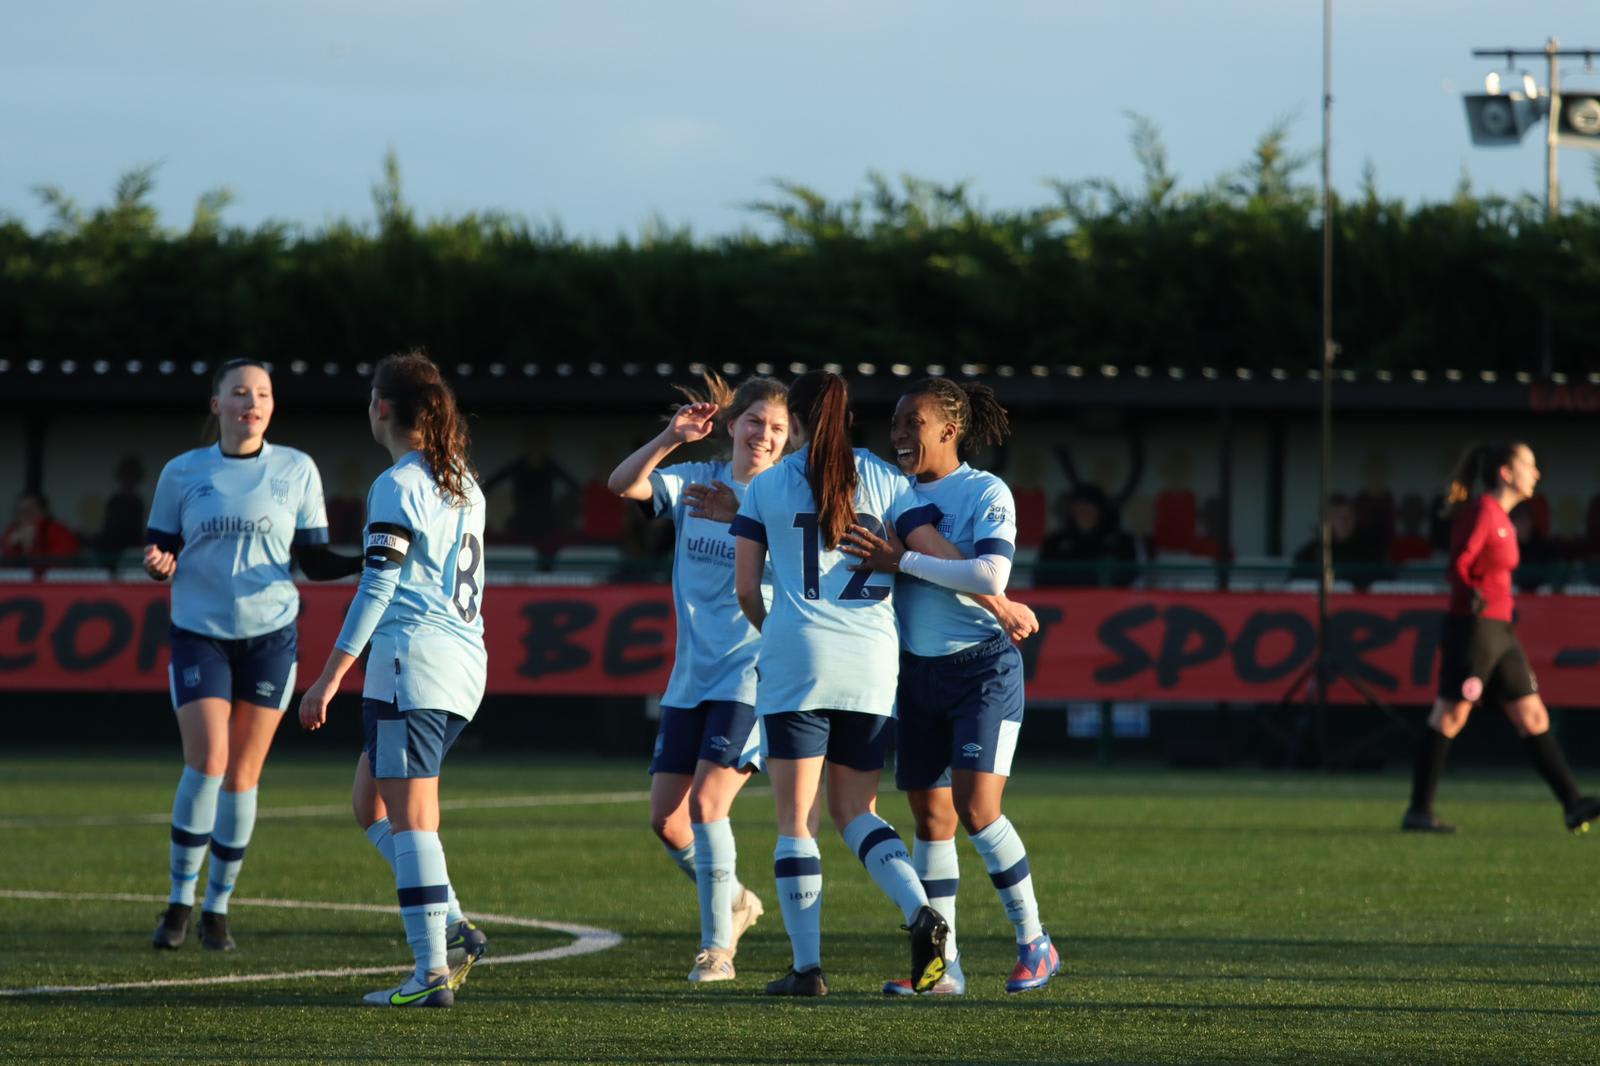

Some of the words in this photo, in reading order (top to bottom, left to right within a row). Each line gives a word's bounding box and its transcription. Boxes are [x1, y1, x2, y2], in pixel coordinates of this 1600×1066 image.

[201, 516, 255, 533] utilita
[687, 536, 737, 560] utilita
[793, 513, 890, 600] 12
[453, 533, 480, 623] 8
[1093, 603, 1518, 692] SPORT
